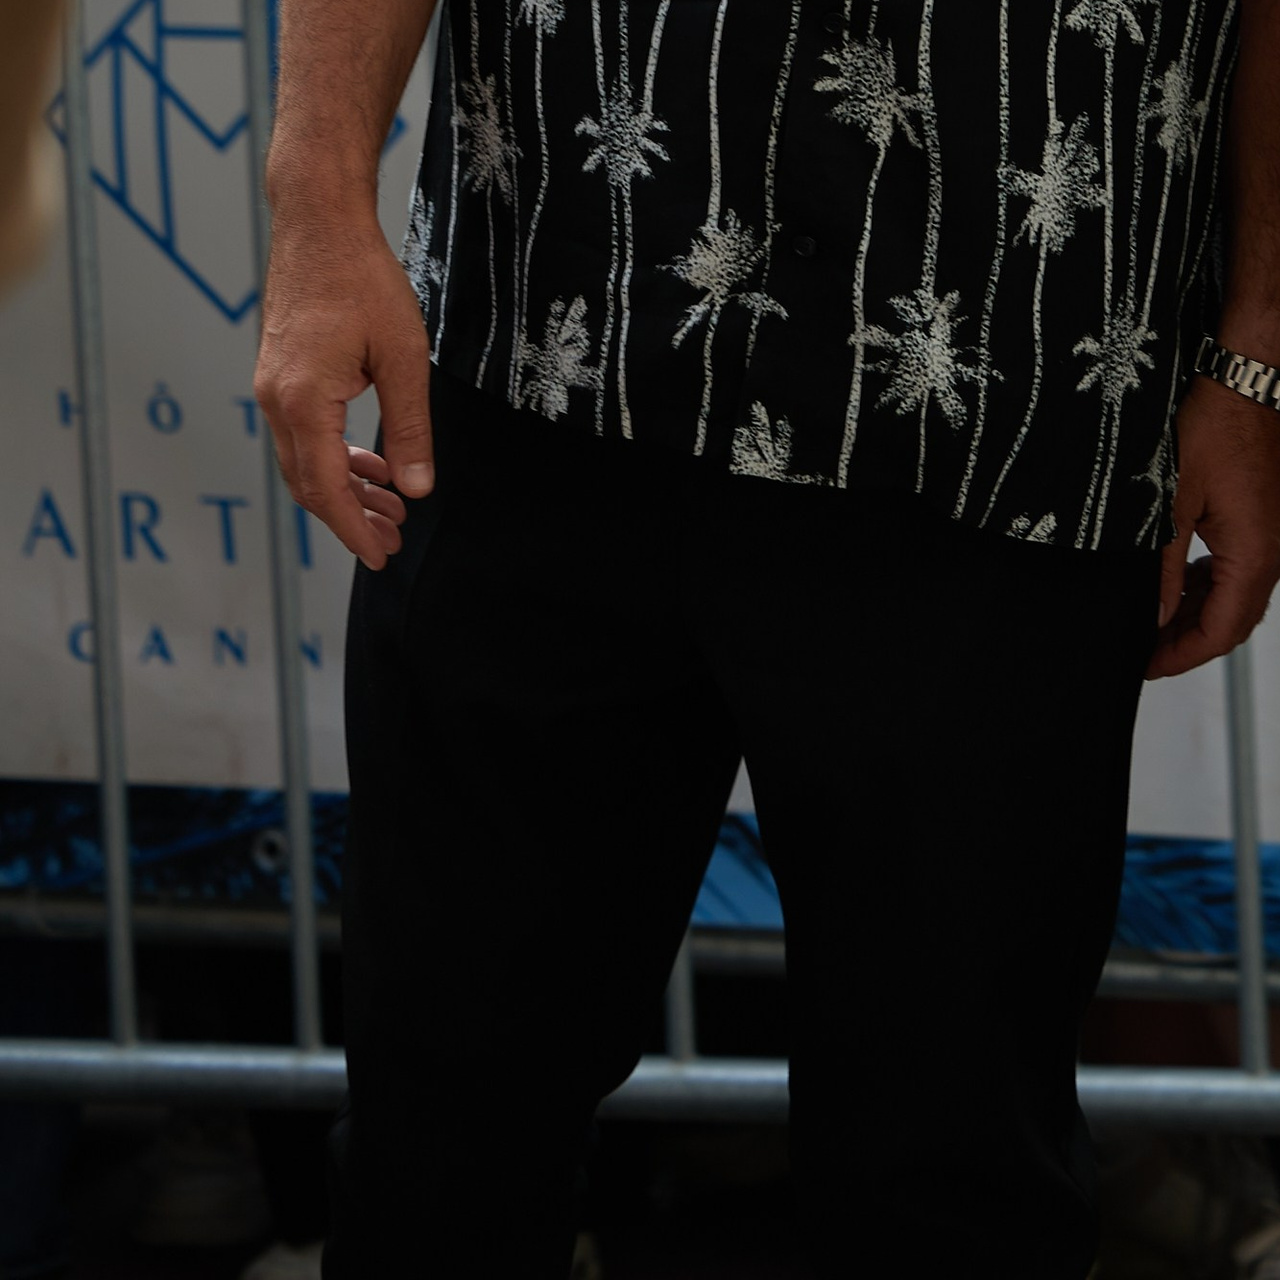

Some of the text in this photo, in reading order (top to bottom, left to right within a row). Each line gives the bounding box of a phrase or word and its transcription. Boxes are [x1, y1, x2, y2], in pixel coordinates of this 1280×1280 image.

[57, 381, 263, 437] HÔT
[22, 488, 315, 569] ARTI
[67, 621, 323, 670] CANN
